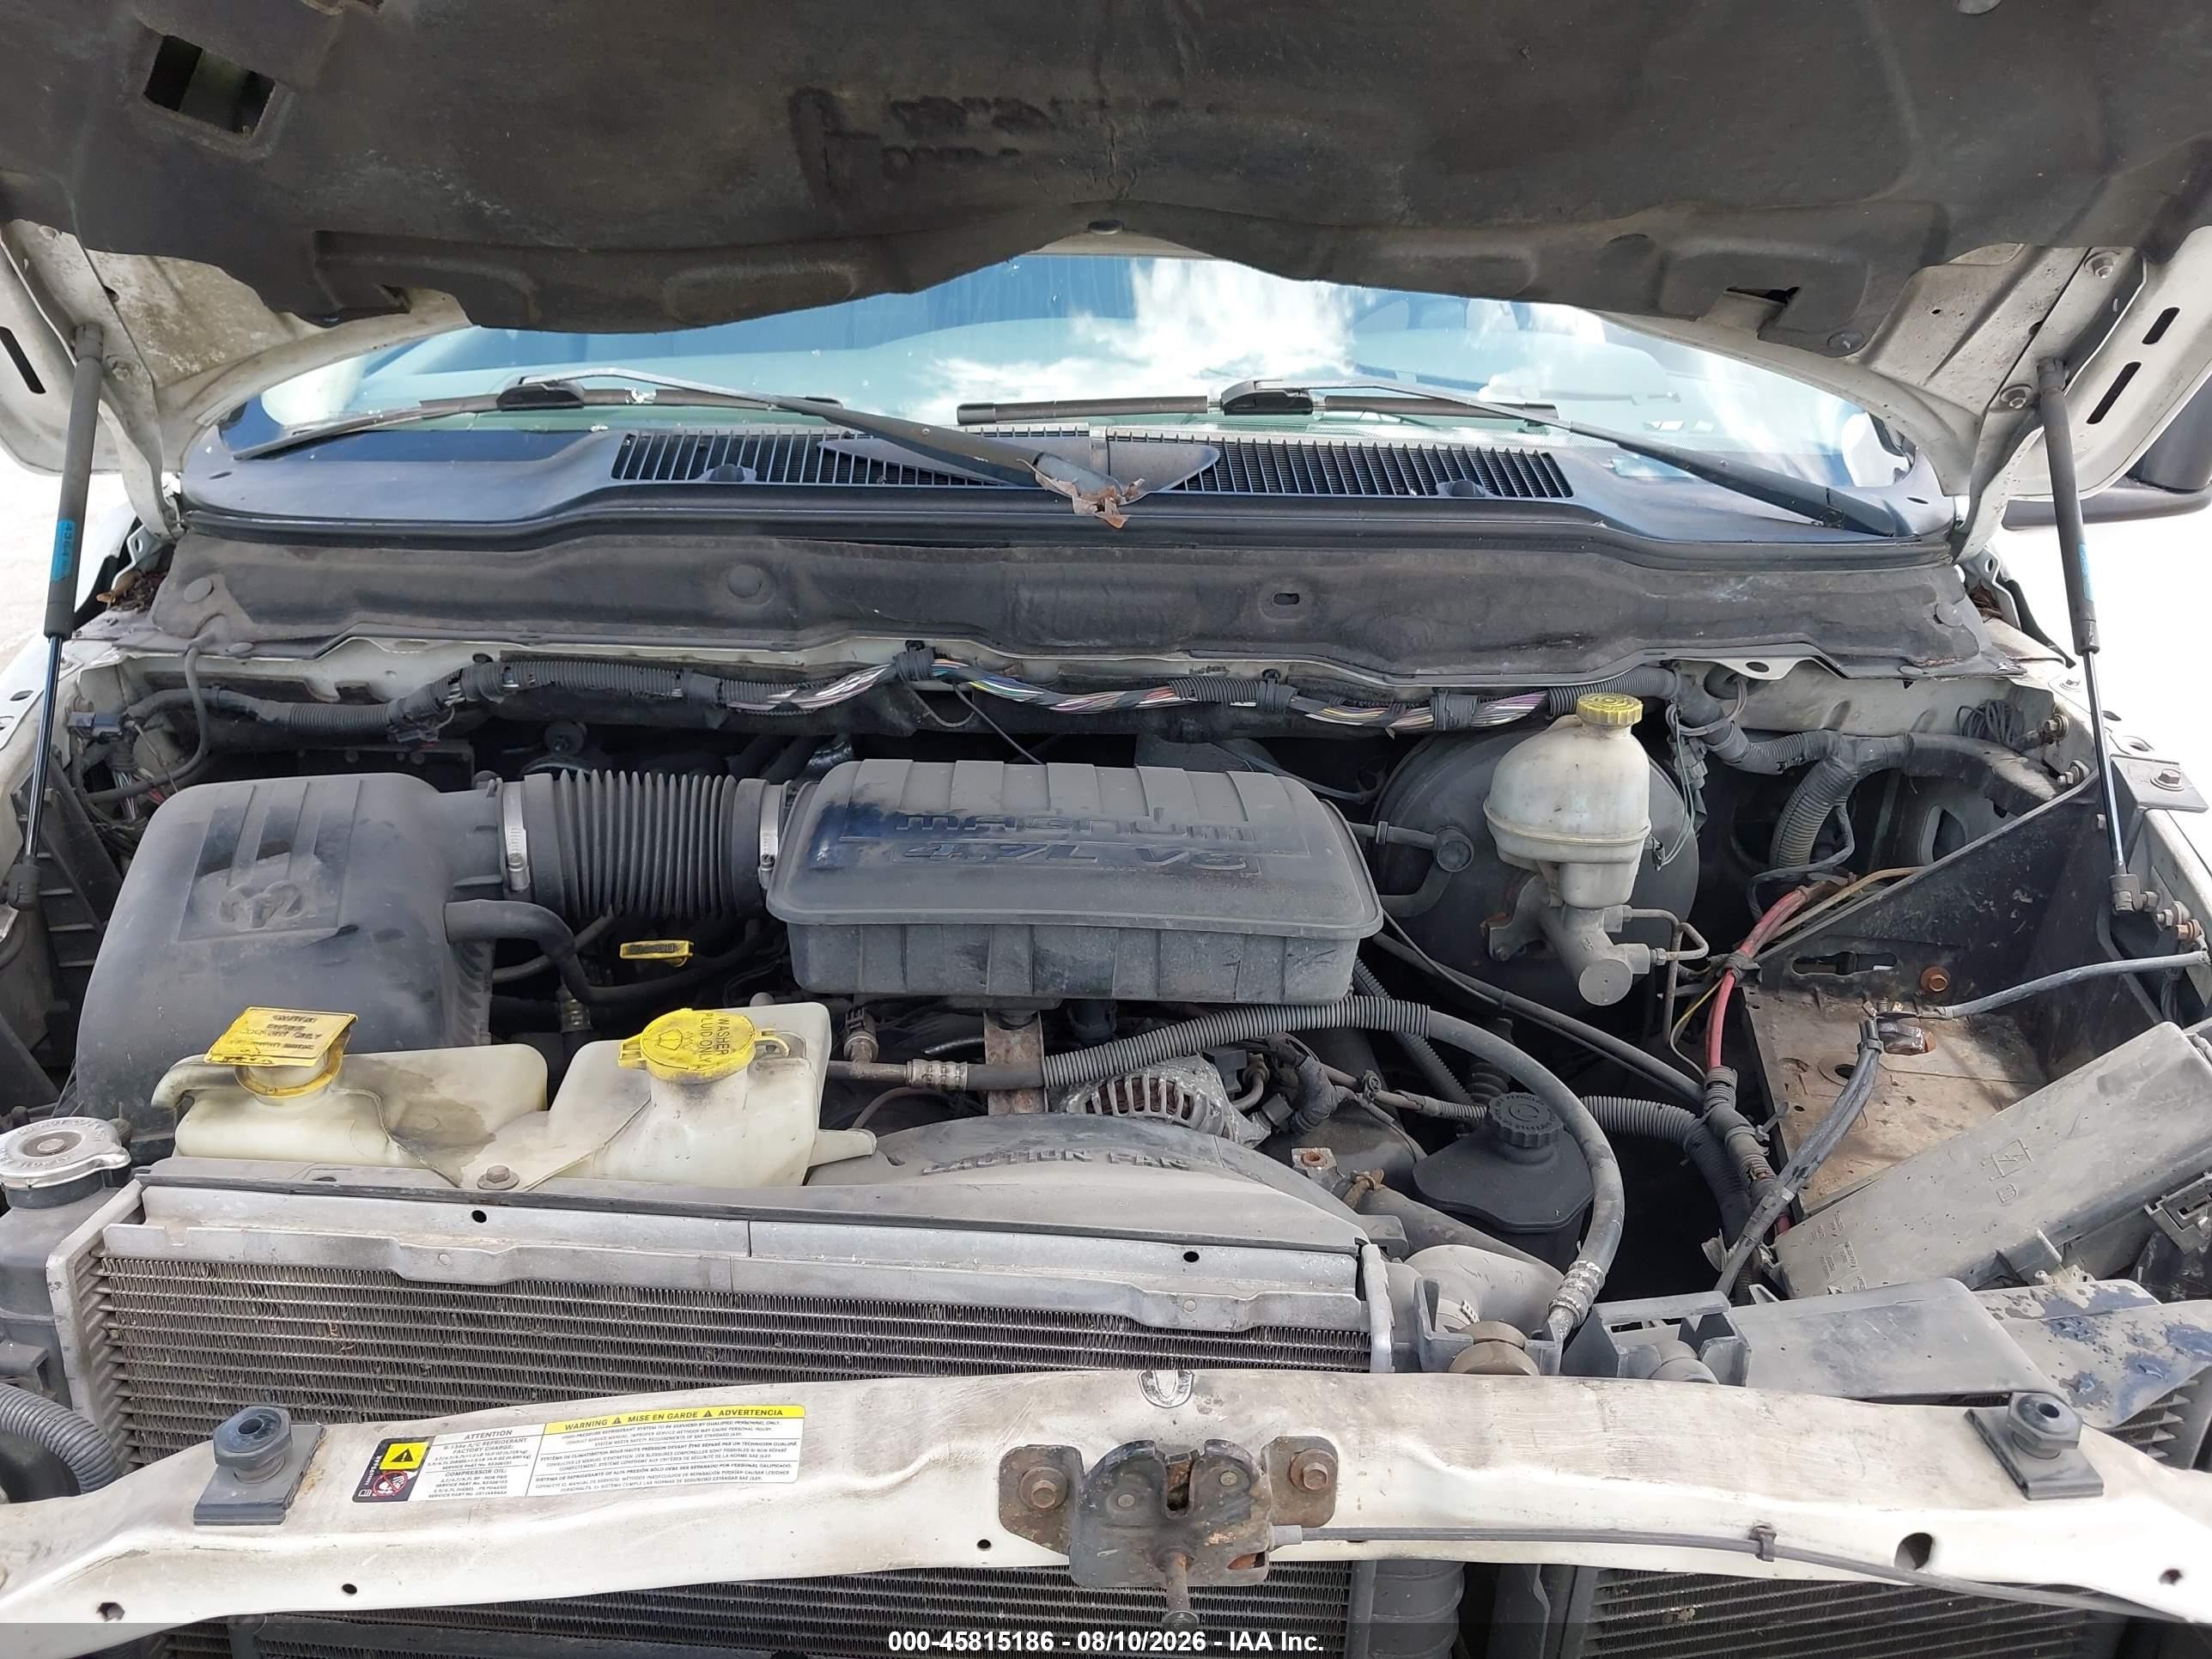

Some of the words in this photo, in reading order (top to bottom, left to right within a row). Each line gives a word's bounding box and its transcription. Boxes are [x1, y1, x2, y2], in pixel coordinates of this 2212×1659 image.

[904, 843, 1099, 863] 4.7L
[1135, 847, 1246, 871] V8
[716, 1018, 730, 1055] WASHER
[699, 1040, 713, 1062] ONLY
[921, 1148, 1092, 1176] CAUTION
[1109, 1152, 1188, 1171] FAN
[565, 1419, 608, 1431] WARNING
[667, 1412, 698, 1420] GARDE
[464, 1430, 513, 1440] ATTENTION
